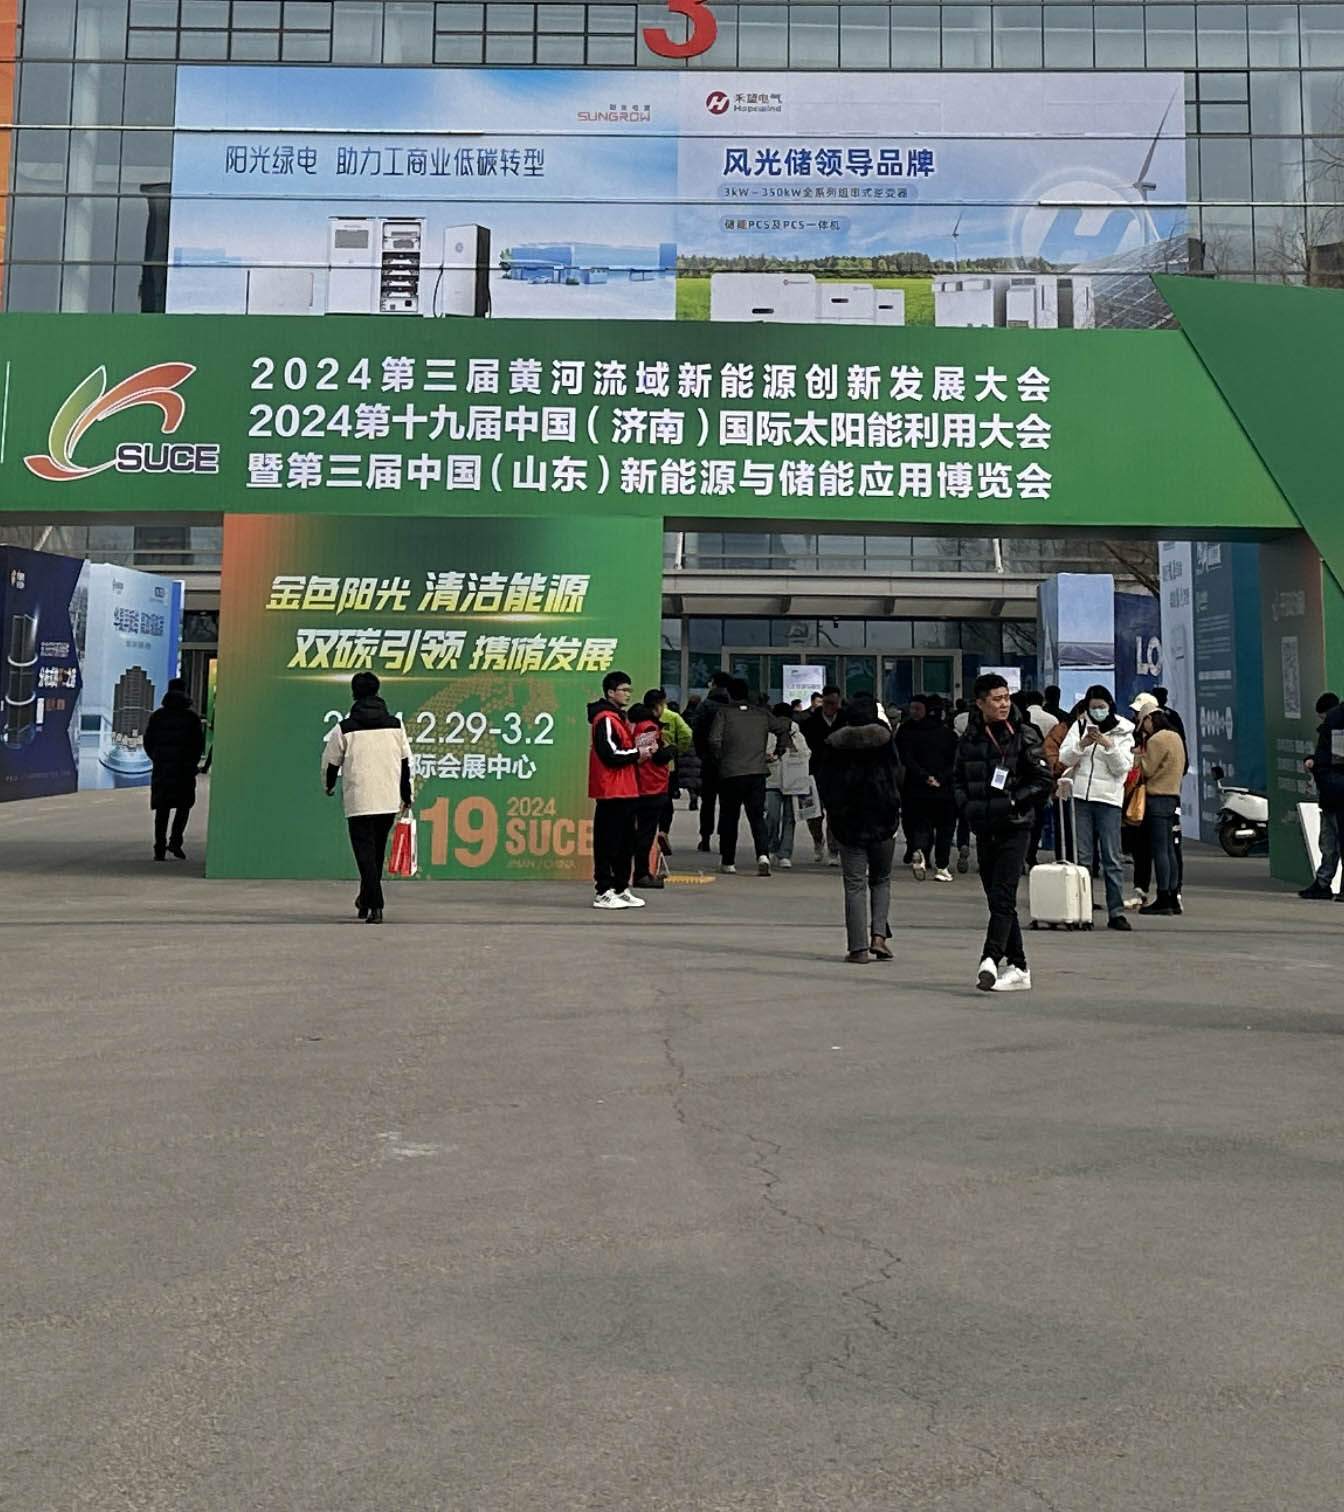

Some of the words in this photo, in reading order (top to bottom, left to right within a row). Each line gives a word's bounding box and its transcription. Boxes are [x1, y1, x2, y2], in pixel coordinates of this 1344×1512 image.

[577, 111, 651, 122] SUNGROW
[225, 145, 317, 176] 阳光绿电
[335, 146, 545, 178] 助力工商业低碳转型
[722, 148, 936, 178] 风光储领导品牌
[250, 355, 1052, 405] 2024第三届黄河流域新能源创新发展大会
[247, 403, 1052, 452] 2024第十九届中国（济南）国际太阳能利用大会
[116, 444, 219, 474] SUCE
[246, 452, 1053, 501] 暨第三届中国（山东）新能源与储能应用博览会
[266, 574, 411, 614] 金色阳光
[416, 571, 590, 613] 清洁能源
[287, 628, 467, 673] 双碳引领
[410, 752, 537, 780] 际会展中心
[507, 796, 557, 816] 2024
[420, 795, 498, 868] 19
